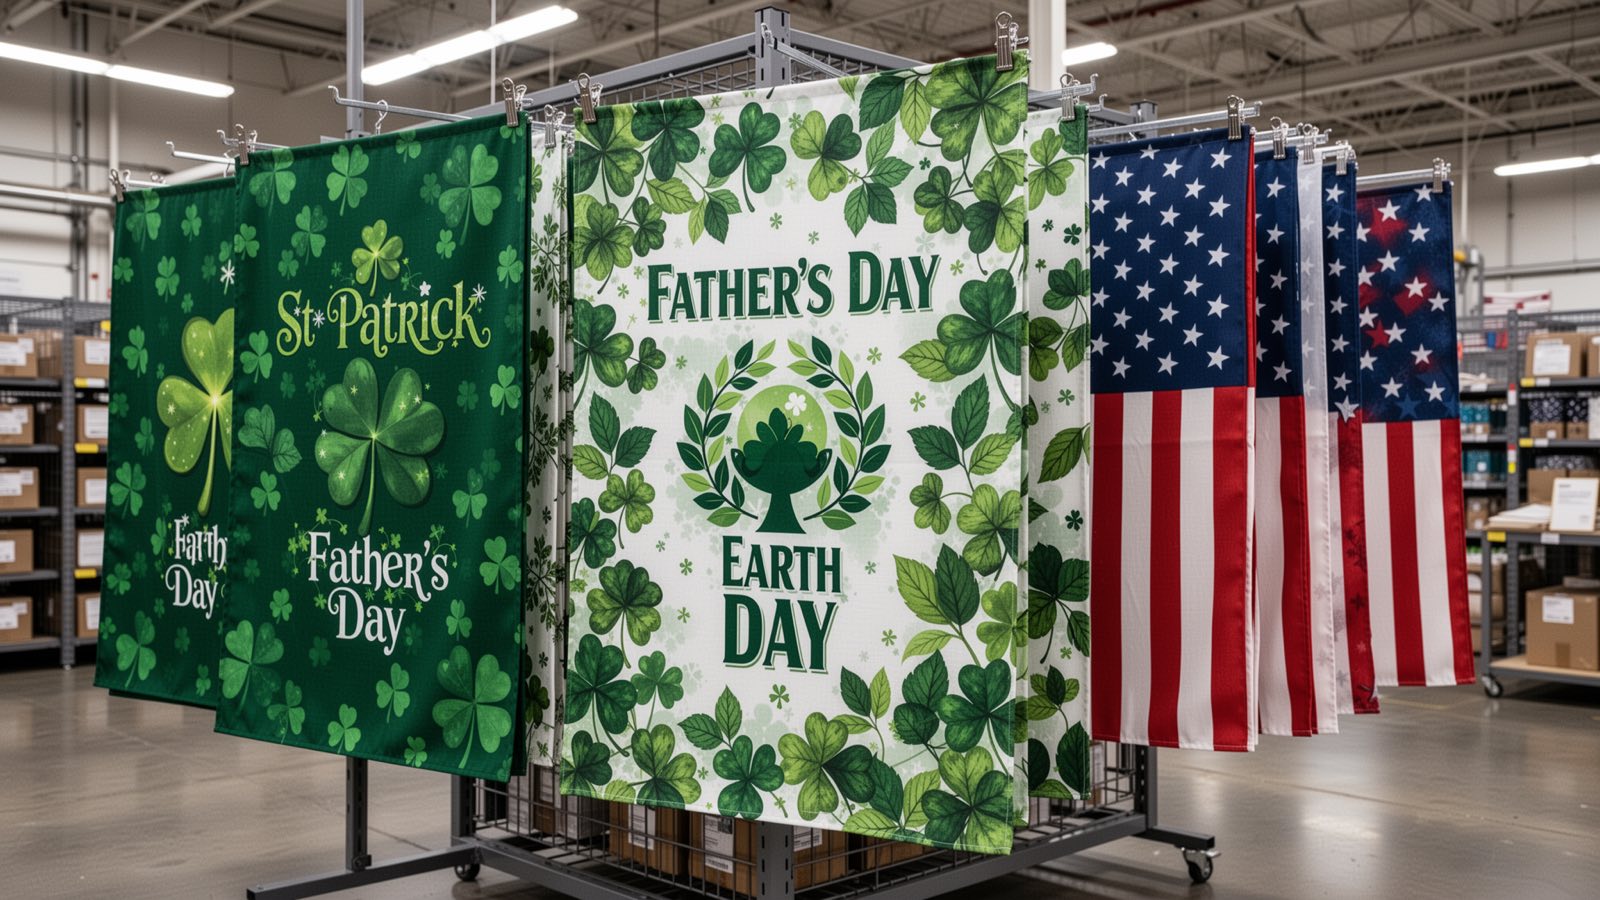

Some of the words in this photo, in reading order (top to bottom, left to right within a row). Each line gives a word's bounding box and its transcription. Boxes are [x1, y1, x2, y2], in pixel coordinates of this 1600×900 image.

[276, 290, 316, 356] St
[327, 281, 491, 358] Patrick
[647, 257, 834, 322] FATHER'S
[848, 251, 940, 315] DAY
[165, 563, 218, 620] Day
[308, 531, 449, 602] Father's
[722, 536, 843, 593] EARTH
[328, 586, 407, 655] Day
[722, 594, 838, 674] DAY
